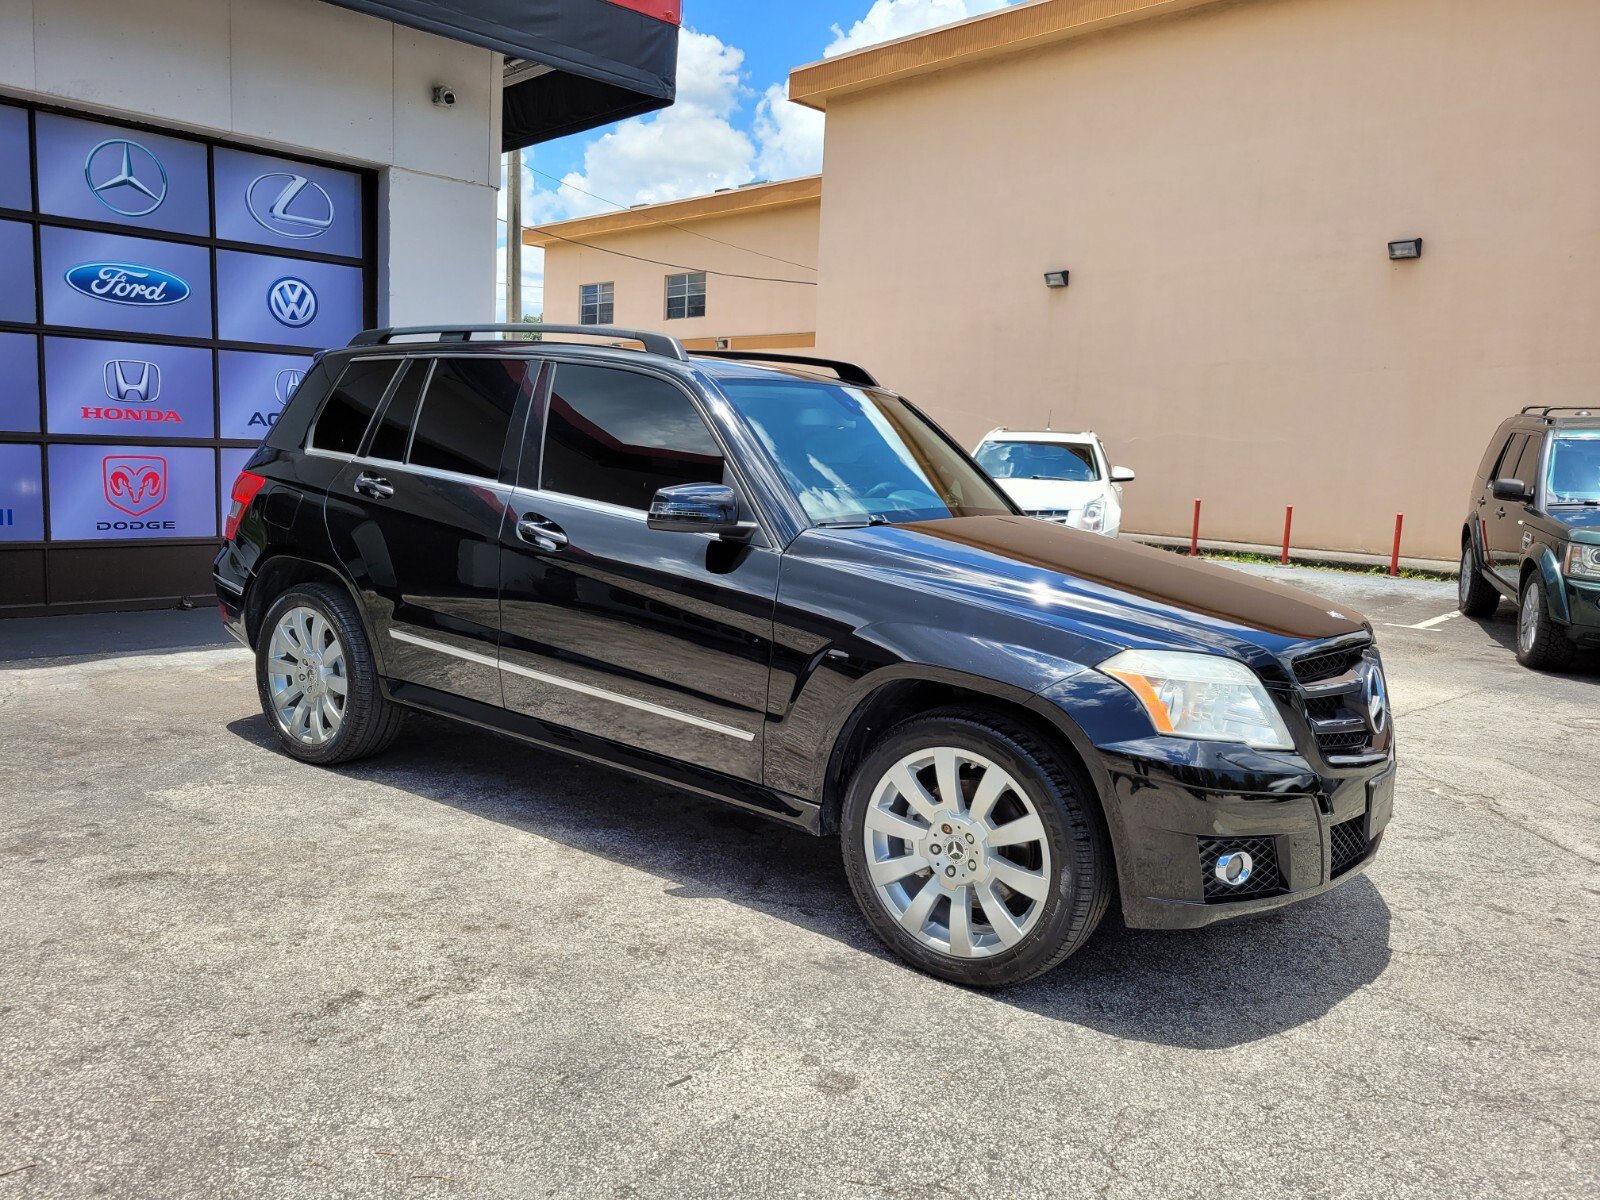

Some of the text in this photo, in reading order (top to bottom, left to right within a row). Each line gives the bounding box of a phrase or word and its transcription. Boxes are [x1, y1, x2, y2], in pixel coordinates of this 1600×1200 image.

[91, 266, 167, 301] Ford
[81, 406, 183, 423] HONDA
[96, 520, 176, 531] DODGE
